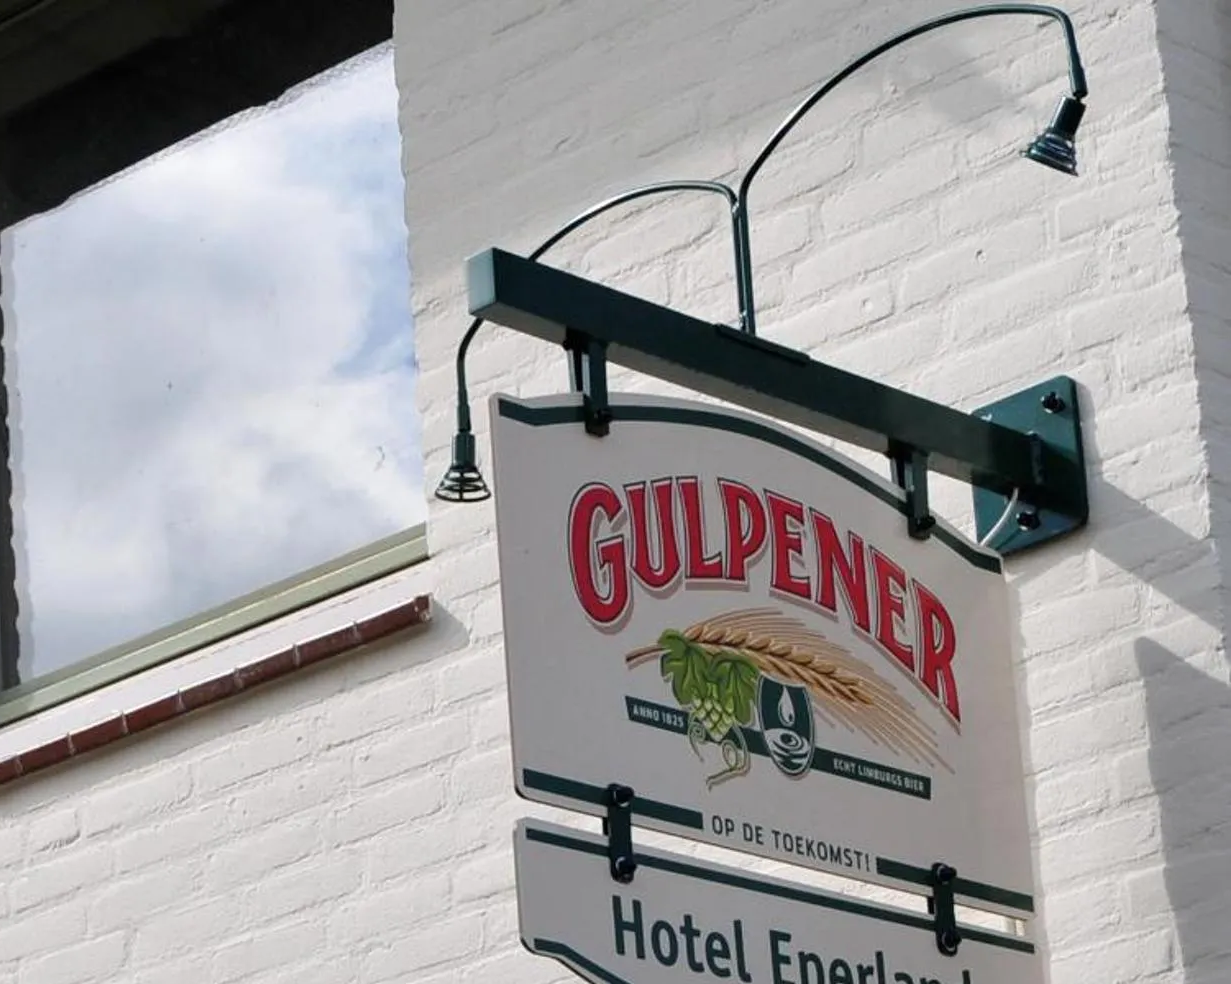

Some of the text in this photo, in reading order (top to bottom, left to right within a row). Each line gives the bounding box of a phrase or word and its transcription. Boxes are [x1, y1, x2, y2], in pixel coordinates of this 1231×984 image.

[568, 475, 962, 735] GULPENER
[632, 703, 684, 729] ANNO 1825
[833, 757, 924, 793] ECHT LIMBURGS BIER
[711, 815, 871, 872] OP DE TOEKOMST!
[612, 895, 751, 983] Hotel
